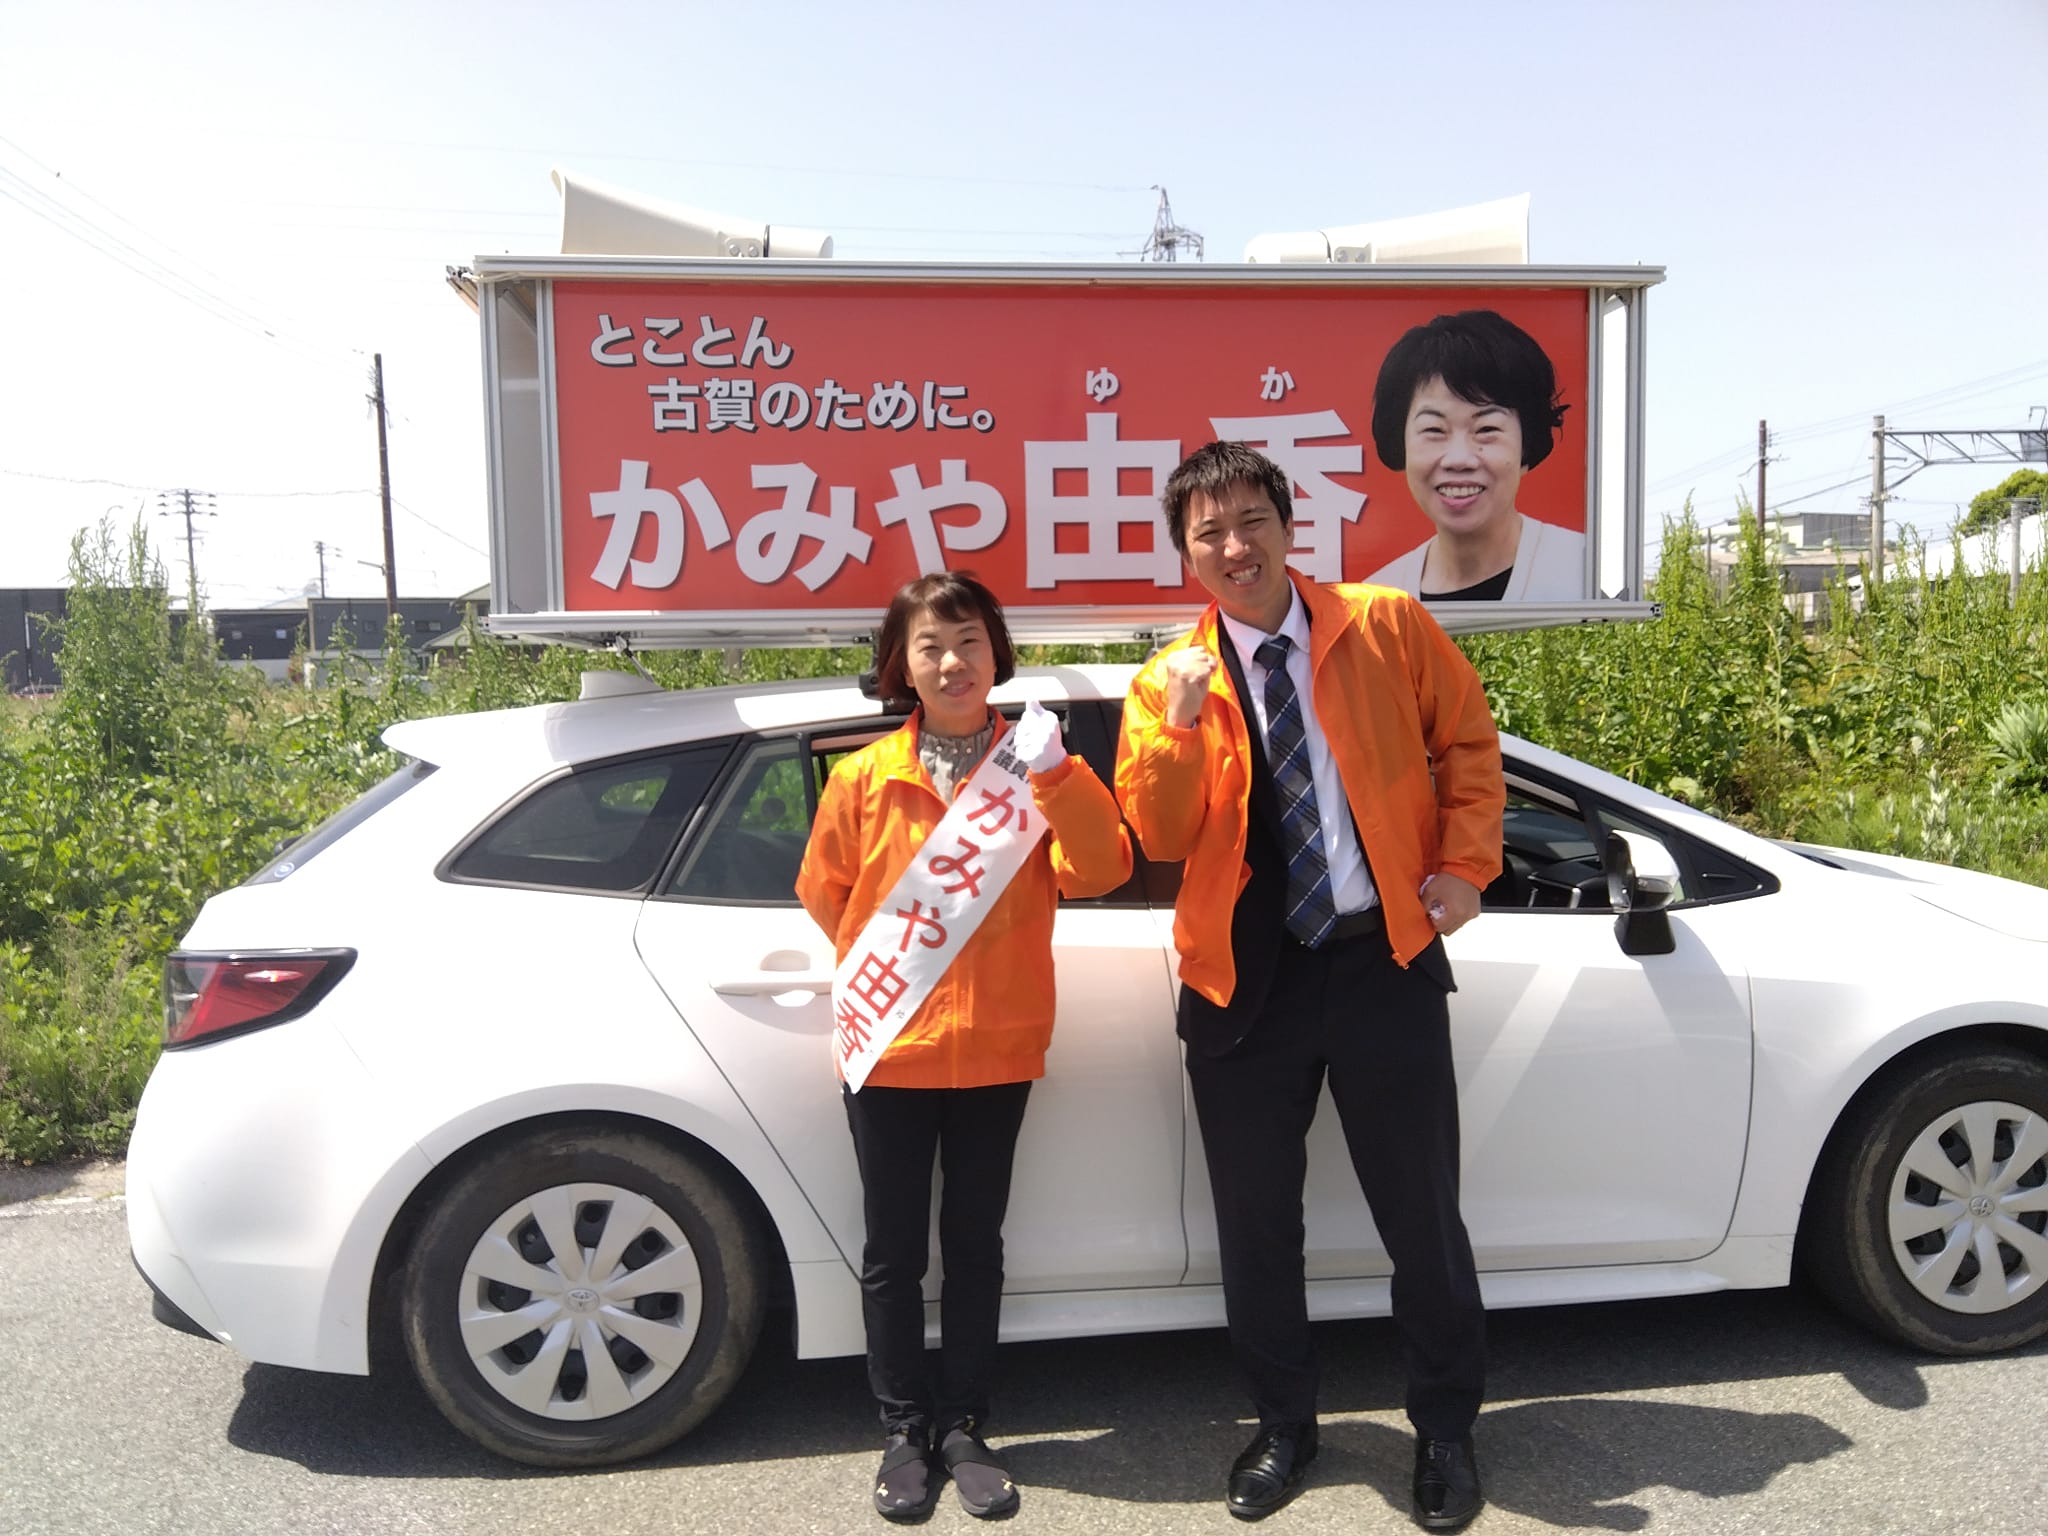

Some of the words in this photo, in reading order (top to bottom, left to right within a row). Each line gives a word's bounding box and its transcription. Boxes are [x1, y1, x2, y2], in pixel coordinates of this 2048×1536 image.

[590, 314, 793, 368] とことん
[647, 376, 995, 432] 古賀のために。
[1086, 366, 1119, 402] ゆ
[1260, 366, 1295, 401] か
